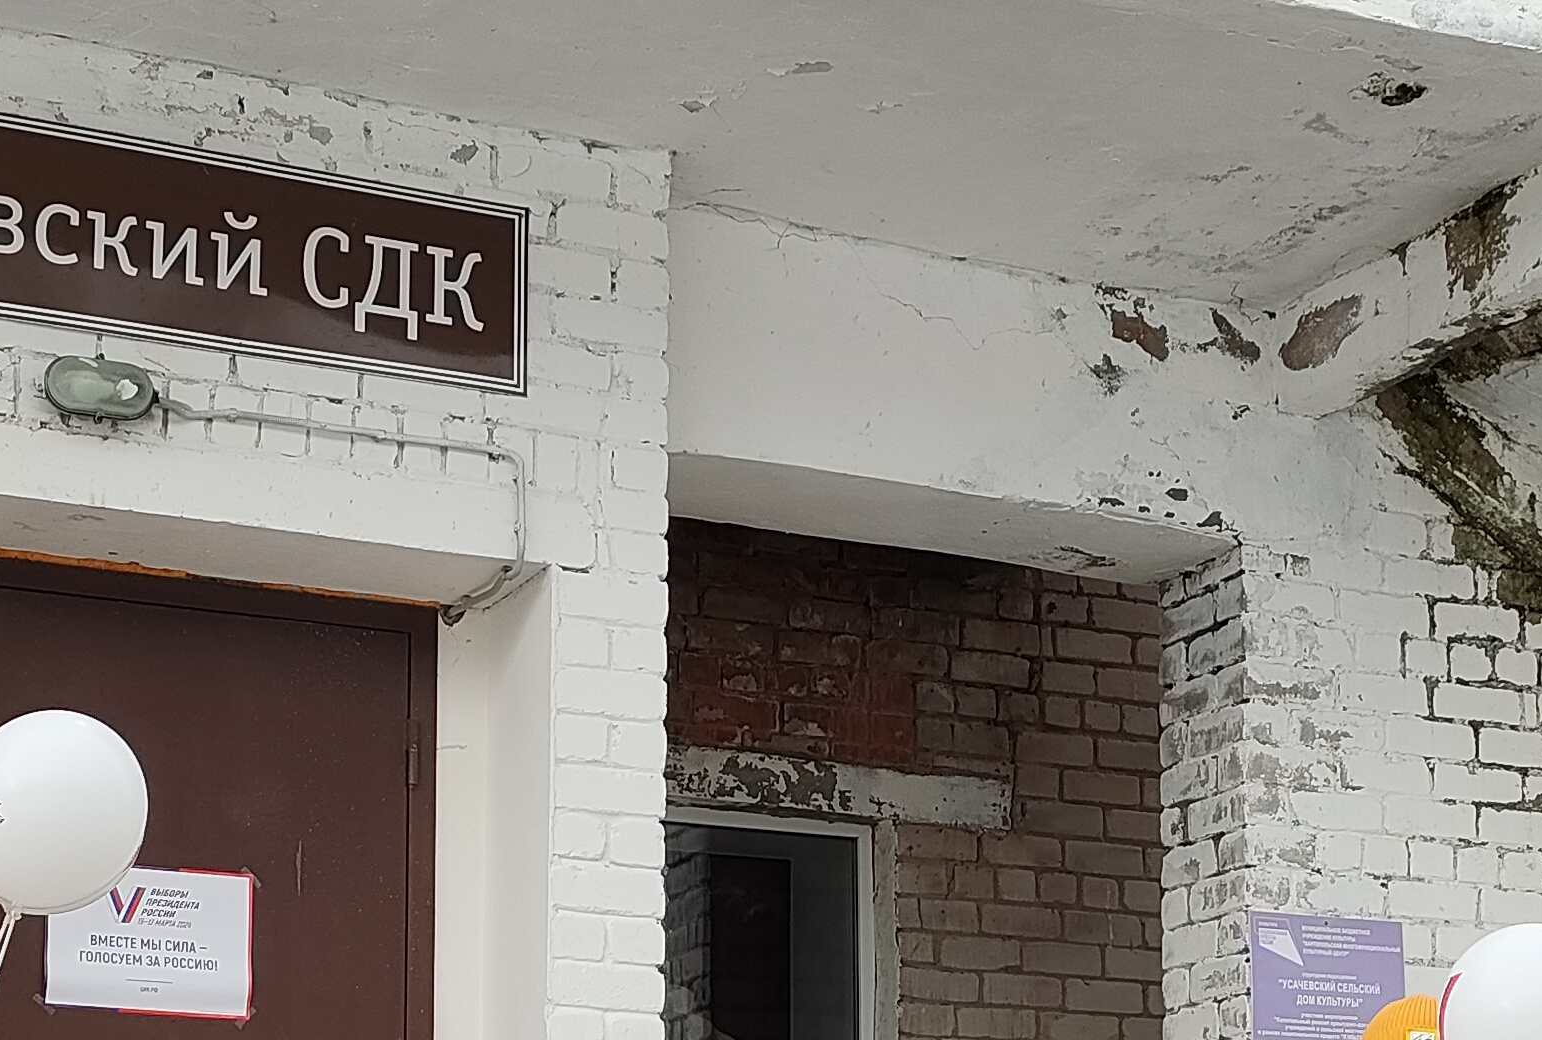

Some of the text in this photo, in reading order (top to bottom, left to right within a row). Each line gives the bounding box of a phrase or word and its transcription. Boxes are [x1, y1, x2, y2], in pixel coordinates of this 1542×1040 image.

[302, 225, 486, 341] СДК
[150, 888, 189, 898] ВЫБОРЫ
[145, 898, 200, 910] ПРЕЗИДЕНТА
[140, 908, 177, 918] РОССИИ
[90, 934, 137, 949] ВМЕСТЕ
[140, 938, 161, 951] МЫ
[165, 940, 196, 953] СИЛА
[78, 949, 218, 971] ГОЛОСУЕМ ЗА РОССИЮ!
[1278, 978, 1381, 995] "УСАЧЕВСКИЙ СЕЛЬСКИЙ
[1296, 994, 1363, 1008] ДОМ КУЛЬТУРЫ"
